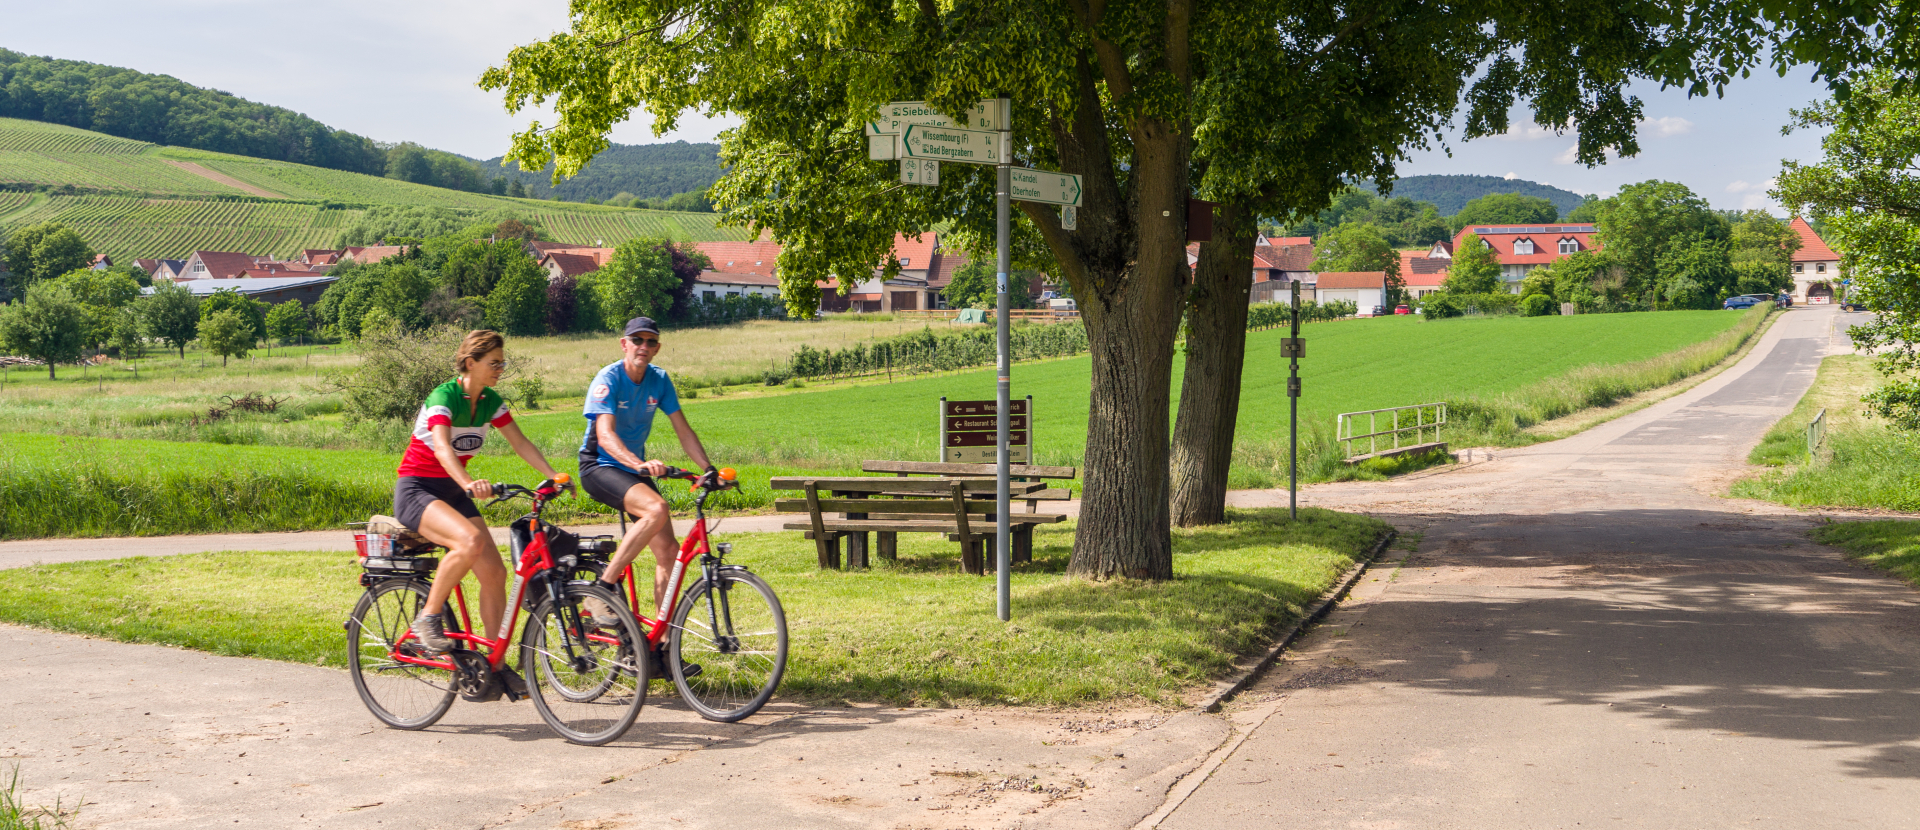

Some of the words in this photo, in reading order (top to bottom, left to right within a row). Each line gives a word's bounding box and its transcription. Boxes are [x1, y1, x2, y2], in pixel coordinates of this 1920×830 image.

[977, 104, 985, 114] 19
[922, 130, 960, 145] Wissembourg
[961, 133, 969, 144] (F)
[985, 135, 991, 145] 14
[930, 145, 940, 155] Bad
[941, 146, 974, 158] Bergzabern
[1018, 173, 1038, 183] Kandel
[1012, 185, 1041, 197] Oberhofen
